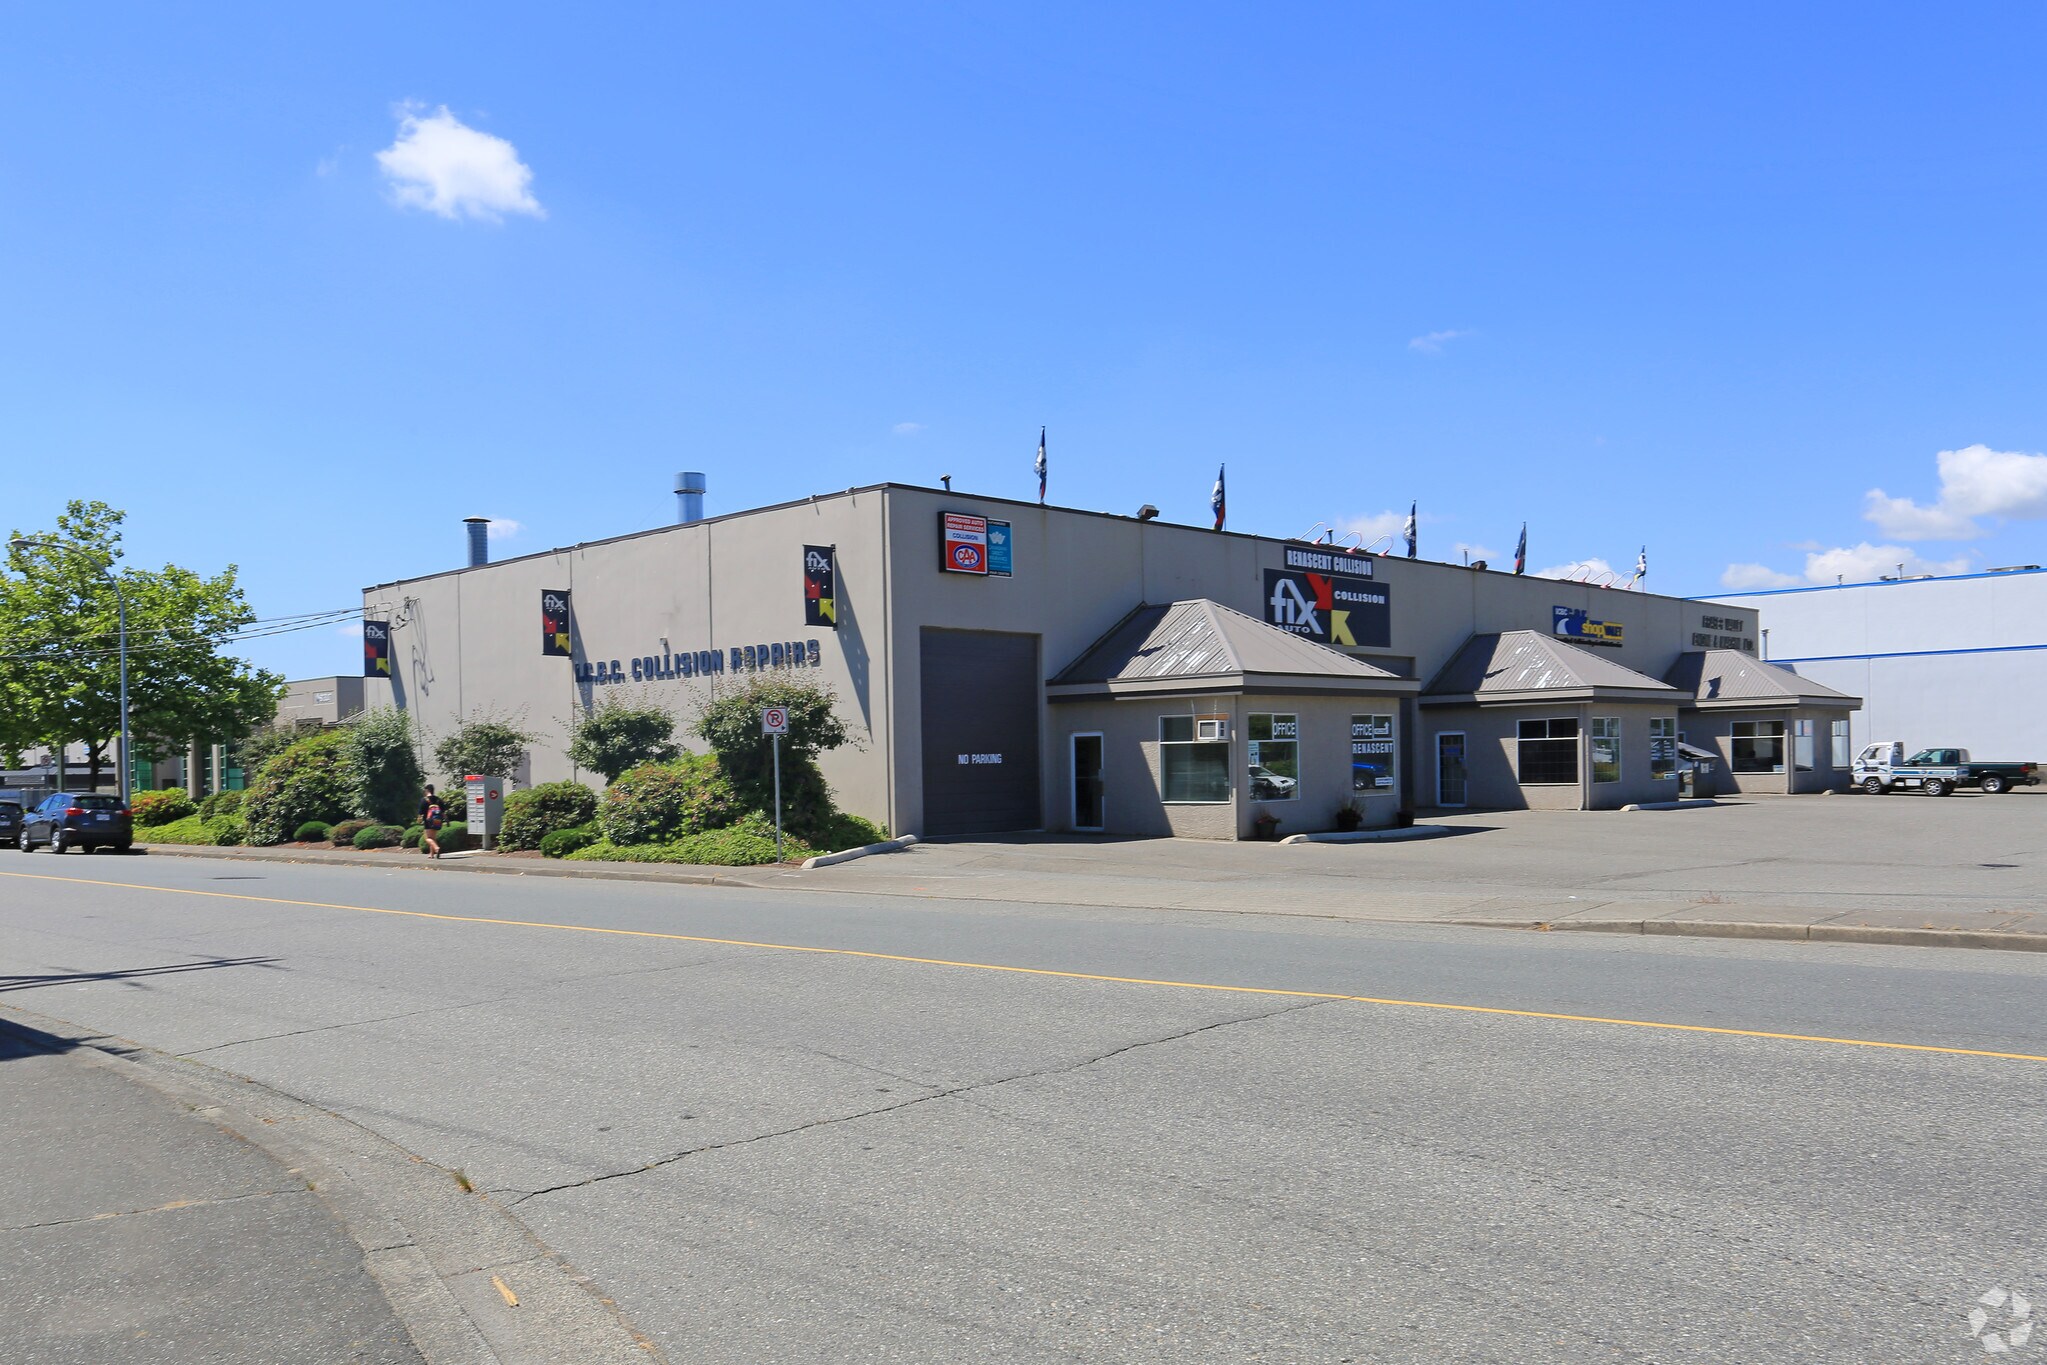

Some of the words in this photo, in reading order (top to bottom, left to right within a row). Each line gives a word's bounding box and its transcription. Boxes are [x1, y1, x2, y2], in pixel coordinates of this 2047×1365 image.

[952, 532, 979, 541] COLLISION
[805, 550, 832, 571] fix
[957, 548, 976, 564] CAA
[1286, 549, 1332, 571] RENASCENT
[1332, 556, 1372, 576] COLLISION
[543, 593, 567, 611] fix
[1333, 590, 1386, 605] COLLISION
[1269, 578, 1325, 635] fix
[365, 624, 387, 640] fix
[1277, 624, 1311, 634] AUTO
[1581, 619, 1604, 638] shop
[631, 648, 724, 679] COLLISION
[771, 713, 780, 724] P
[1272, 722, 1297, 736] OFFICE
[1351, 723, 1374, 736] OFFICE
[1352, 743, 1393, 754] RENASCENT
[957, 754, 969, 765] NO
[971, 753, 1002, 764] PARKING
